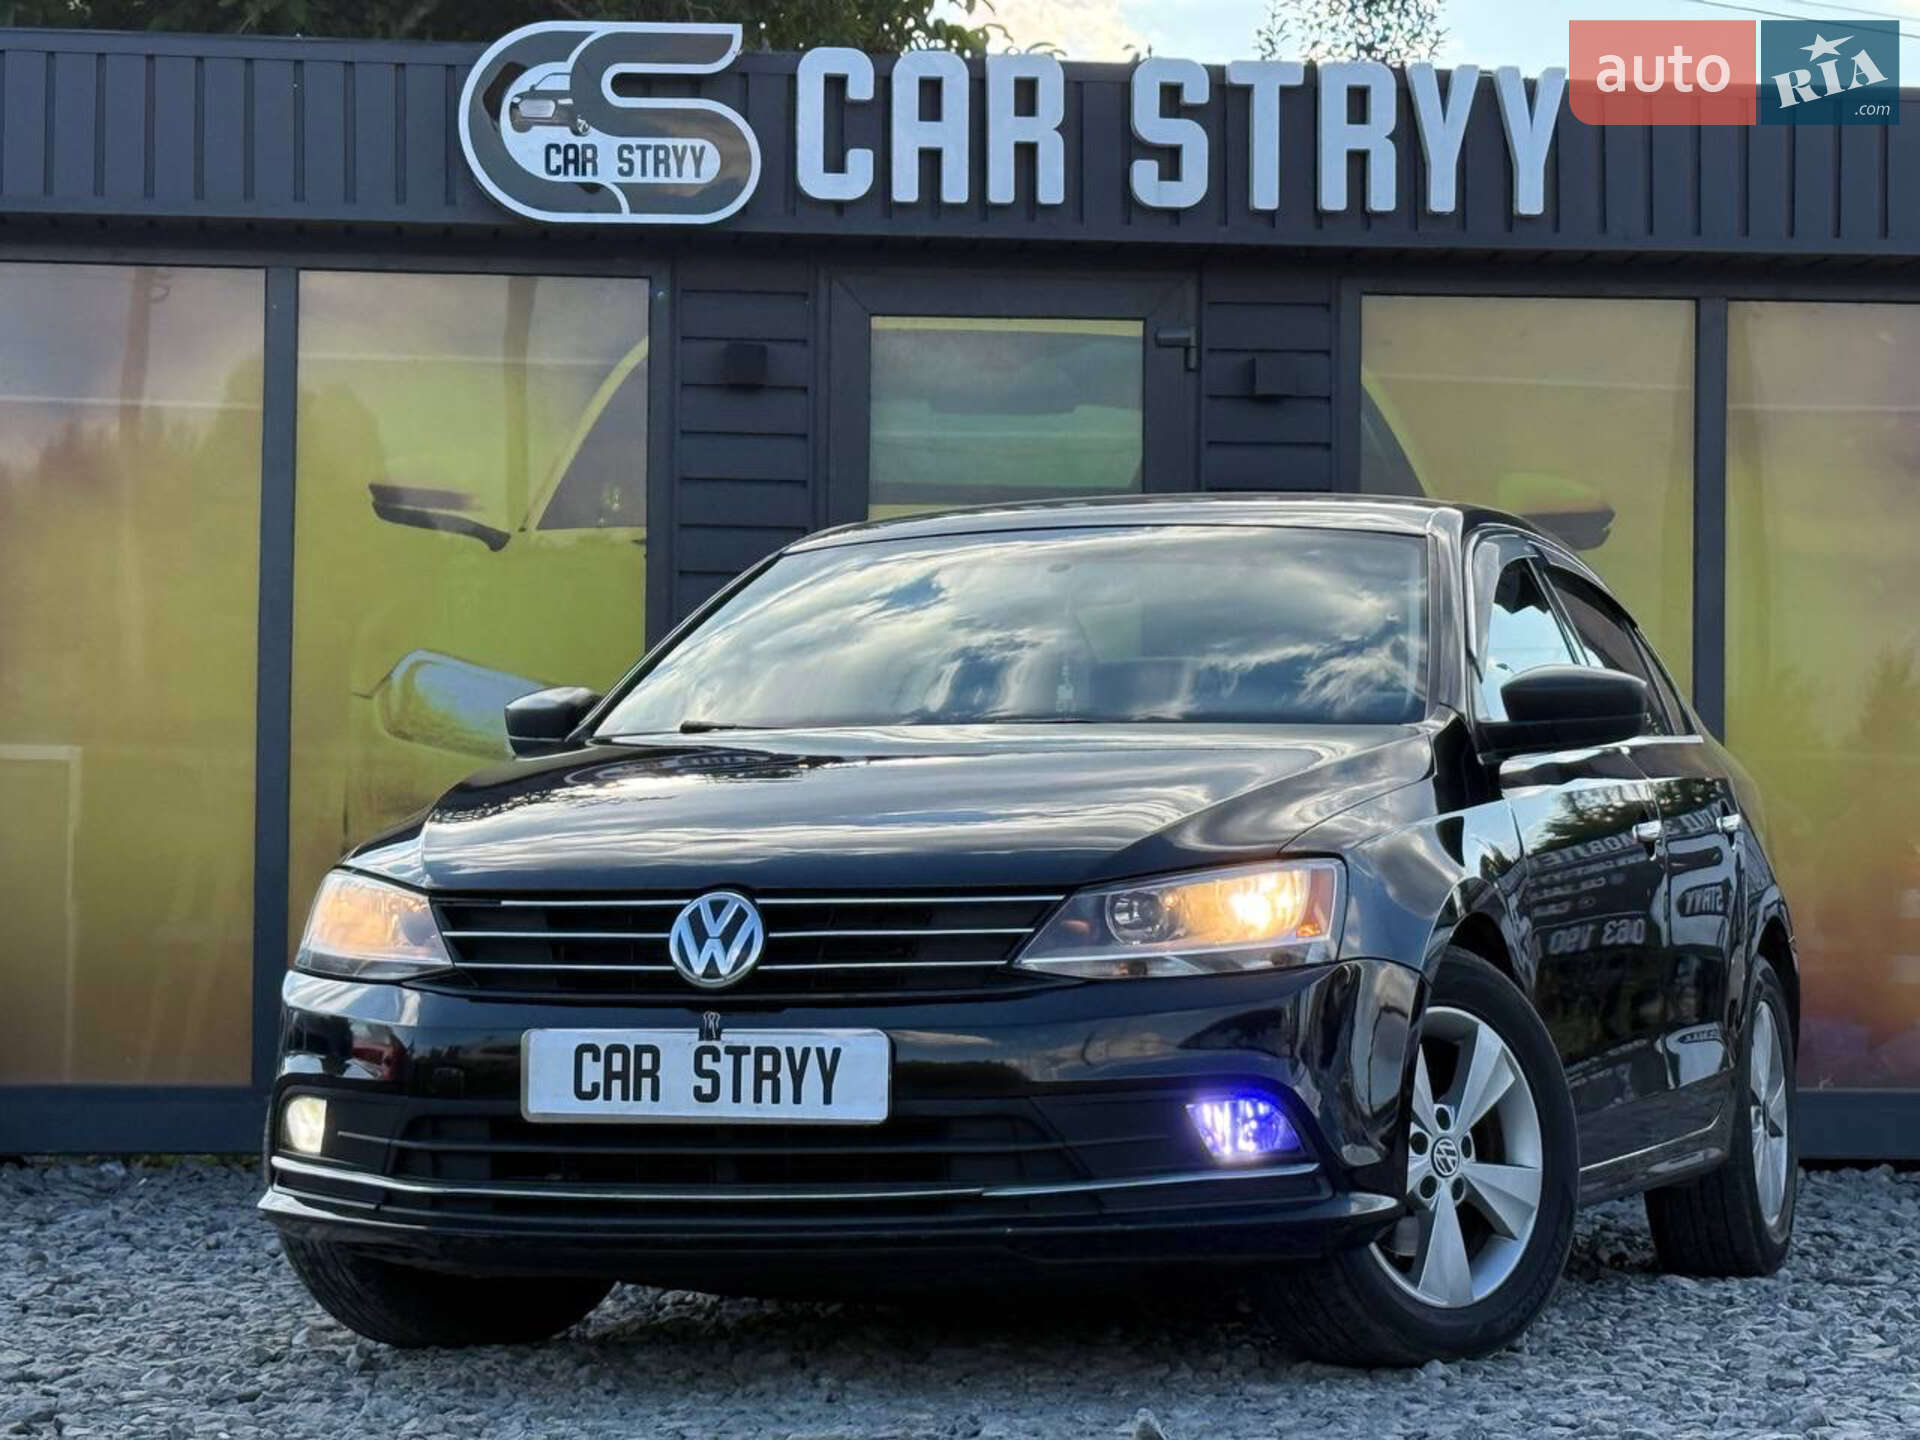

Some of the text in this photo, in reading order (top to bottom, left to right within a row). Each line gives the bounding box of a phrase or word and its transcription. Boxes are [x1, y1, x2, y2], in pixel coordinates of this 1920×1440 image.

[544, 143, 706, 179] CAR STRYY
[797, 47, 1566, 216] CAR STRYY
[573, 1042, 842, 1105] CAR STRYY
